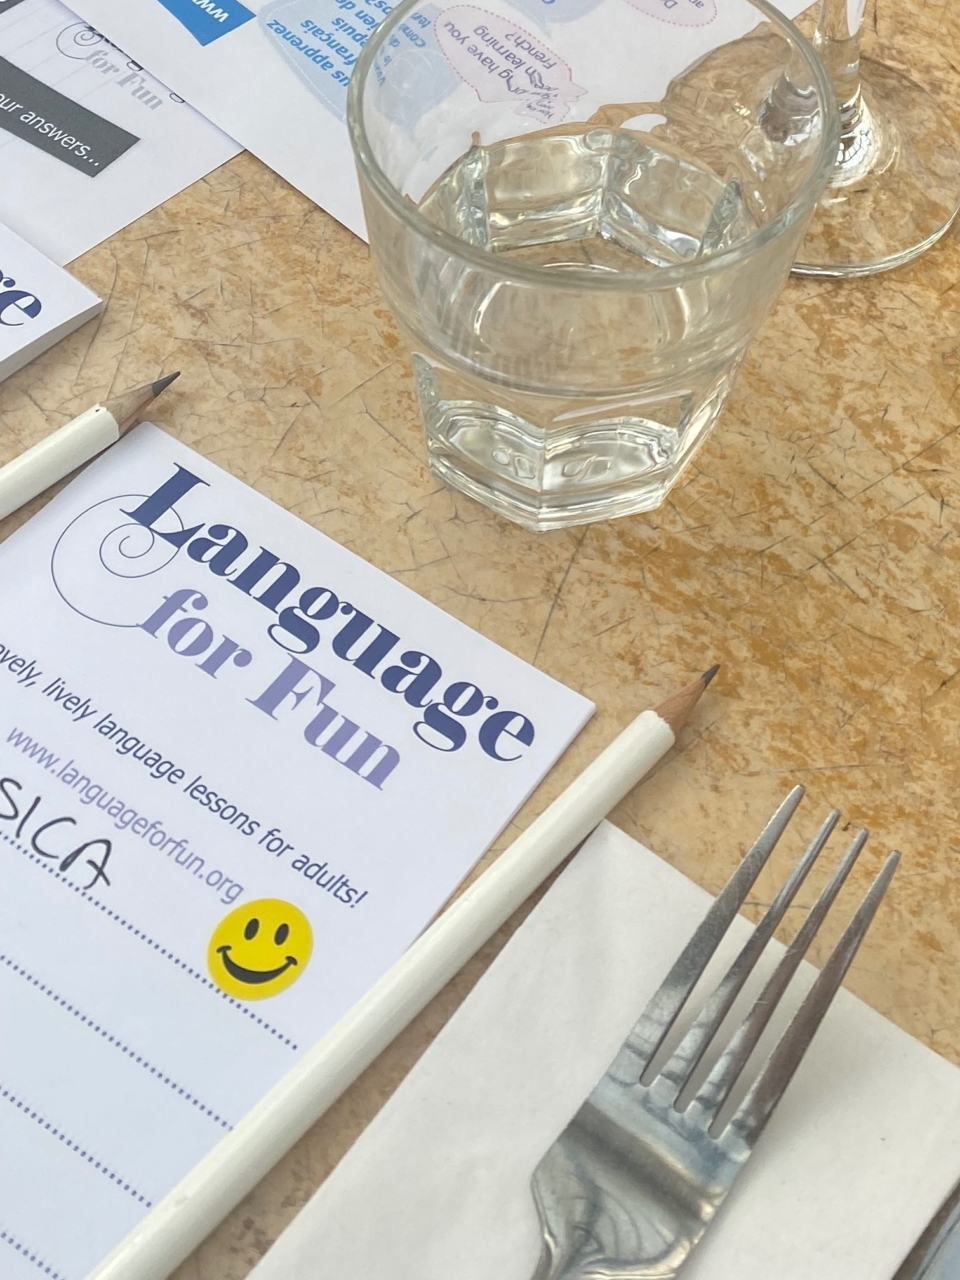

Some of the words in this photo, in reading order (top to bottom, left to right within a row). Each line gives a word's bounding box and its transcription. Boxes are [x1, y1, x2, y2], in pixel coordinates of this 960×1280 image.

[266, 19, 336, 72] apprenez
[300, 19, 359, 66] français
[443, 21, 471, 46] you
[466, 43, 502, 74] have
[473, 25, 527, 70] learning
[504, 31, 558, 70] French?
[84, 49, 121, 75] for
[114, 71, 164, 111] Fun
[20, 110, 100, 167] answers...
[112, 462, 537, 763] Language
[136, 587, 253, 681] for
[243, 651, 402, 791] Fun
[6, 726, 245, 905] www.languageforfun.org
[41, 677, 98, 723] lively
[92, 713, 186, 785] language
[182, 775, 261, 837] lessons
[257, 827, 295, 858] for
[291, 853, 369, 909] adults!
